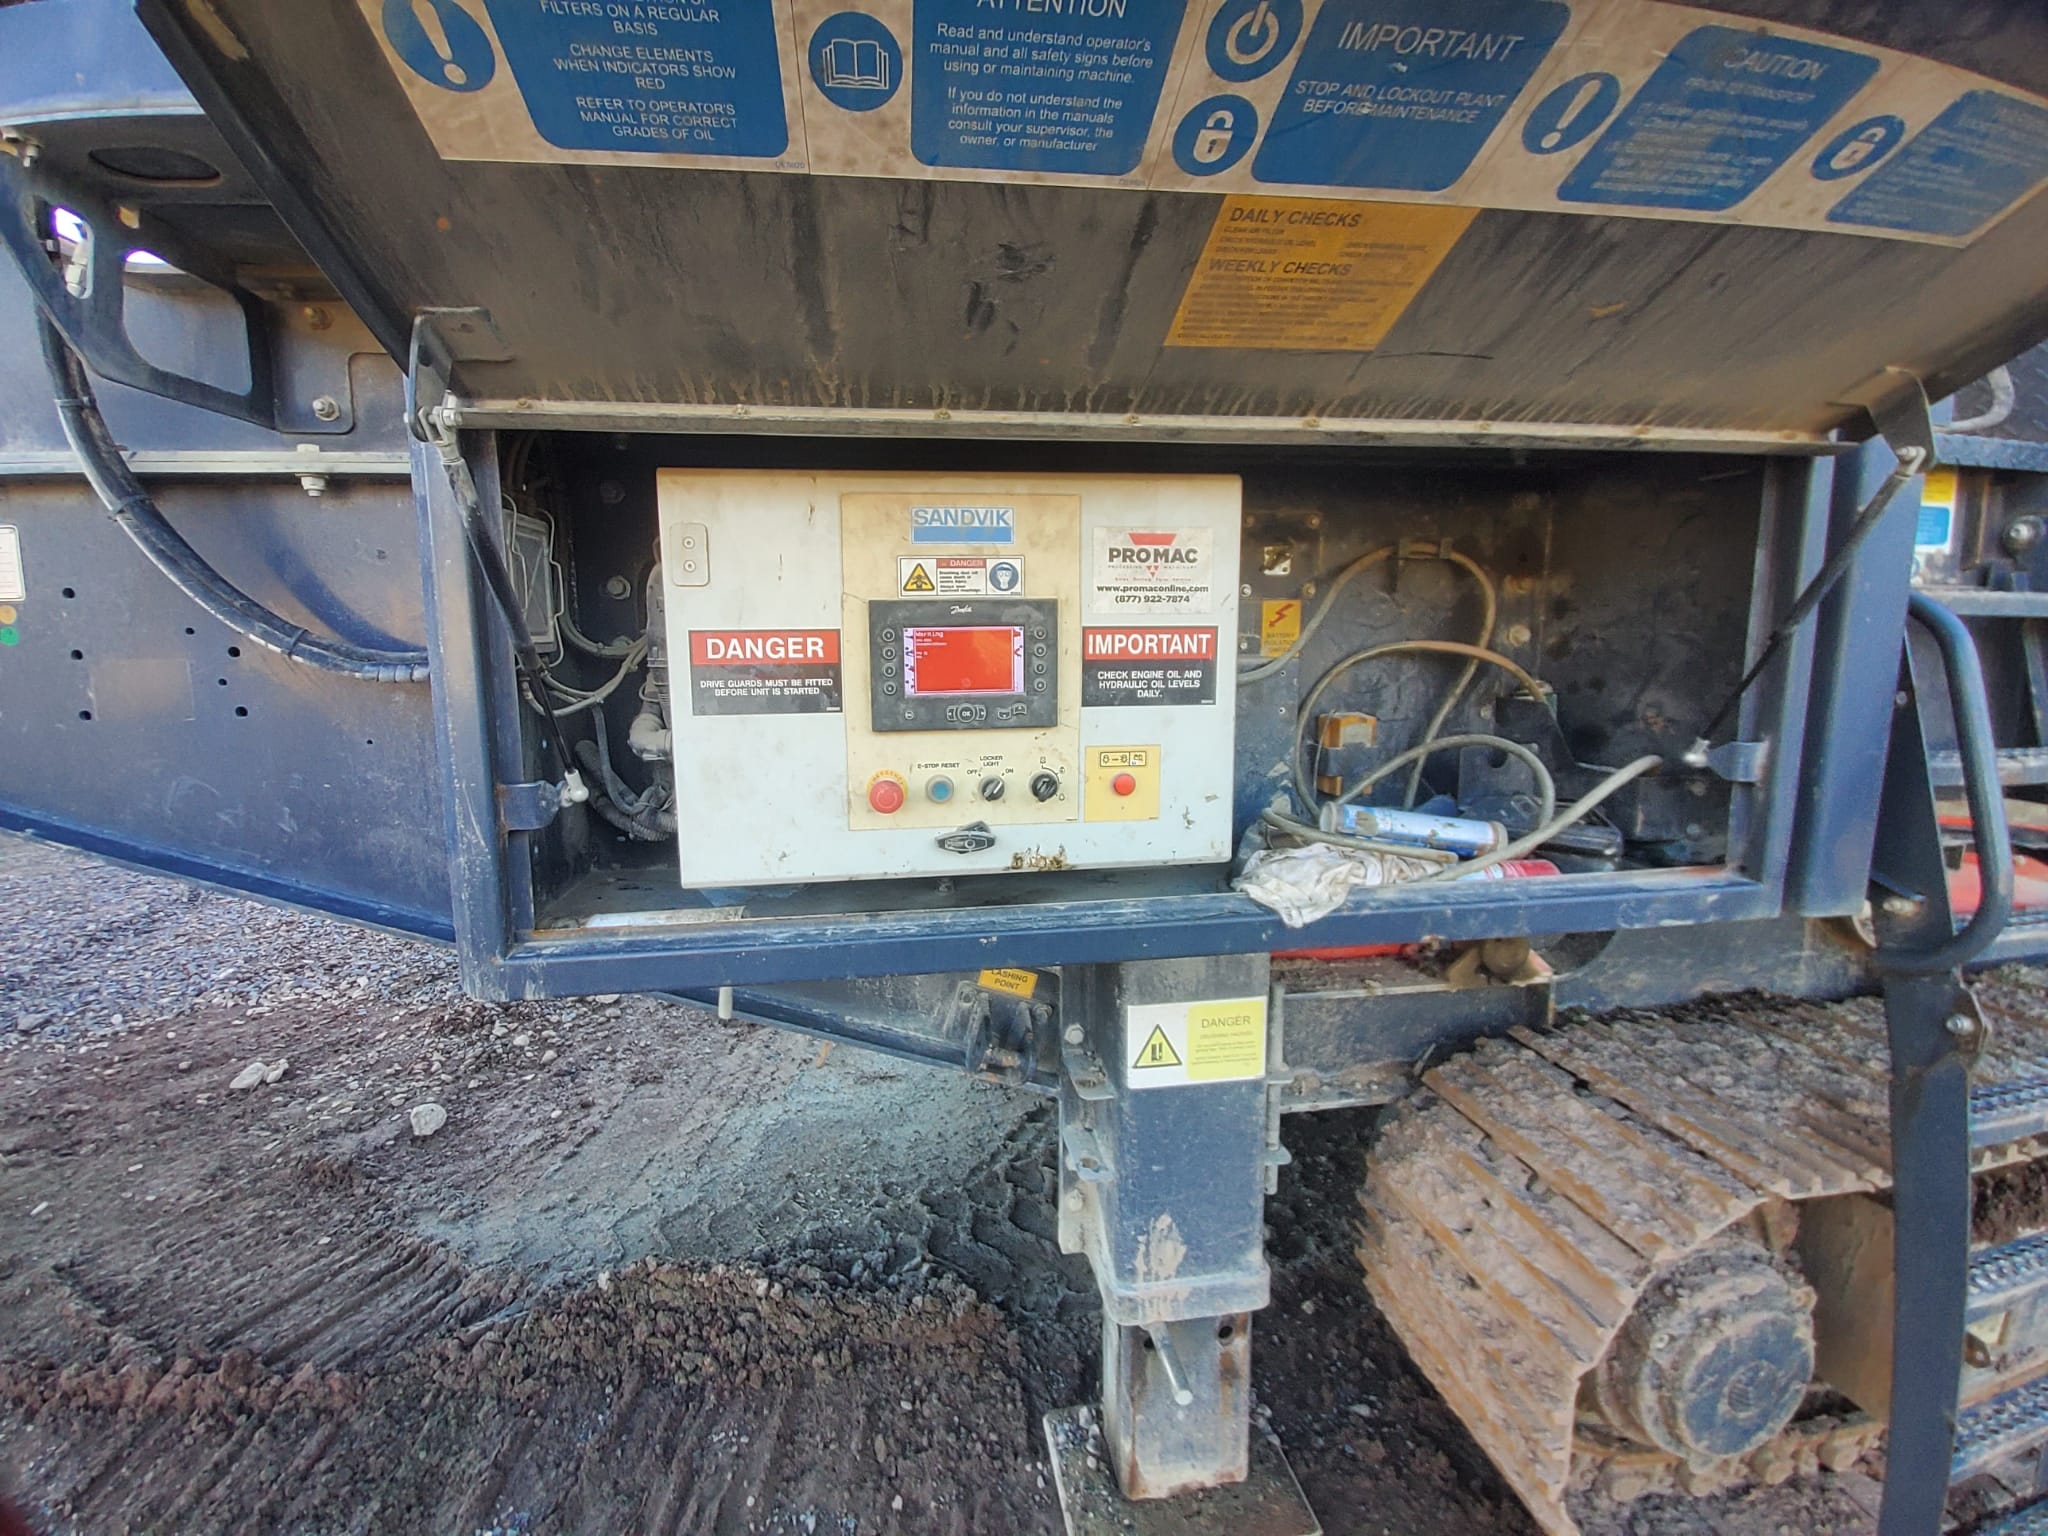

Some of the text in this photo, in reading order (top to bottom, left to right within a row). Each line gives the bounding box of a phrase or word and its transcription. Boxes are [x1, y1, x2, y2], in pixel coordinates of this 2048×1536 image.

[541, 0, 720, 22] FILTERS ON A REGULAR
[613, 21, 658, 36] BASIS
[937, 22, 1151, 52] Read and understand operator's
[1338, 21, 1525, 62] IMPORTANT
[570, 43, 714, 63] CHANGE ELEMENTS
[930, 42, 1153, 69] manual and all safety signs before
[553, 59, 736, 79] WHEN INDICATORS SHOW
[944, 59, 979, 76] using
[983, 64, 997, 74] or
[1000, 64, 1074, 82] maintaining
[1723, 48, 1830, 80] CAUTION
[636, 76, 665, 90] RED
[948, 87, 1123, 110] If you do not understand the
[1295, 80, 1507, 108] STOP AND LOCKOUT PLANT
[576, 97, 736, 116] REFER TO OPERATOR'S
[952, 102, 1114, 124] information in the manuals
[1303, 98, 1480, 124] BEFORE MAINTENANCE
[580, 111, 737, 129] MANUAL FOR CORRECT
[948, 119, 992, 132] consult
[995, 122, 1023, 136] your
[1095, 126, 1113, 139] the
[612, 125, 716, 142] GRADES OF OIL
[1004, 136, 1017, 148] or
[1230, 208, 1362, 228] DAILY CHECKS
[1209, 258, 1352, 276] WEEKLY CHECKS
[914, 508, 1010, 526] SANDVIK
[950, 559, 984, 567] DANGER
[1108, 547, 1198, 564] PROMAC
[1097, 584, 1209, 594] www.promaconline.com
[1115, 595, 1190, 604] (877) 922-7874
[706, 637, 824, 660] DANGER
[1088, 633, 1211, 655] IMPORTANT
[700, 680, 724, 688] DRIVE
[765, 679, 788, 687] MUST
[805, 678, 833, 686] FITTED
[1098, 670, 1203, 680] CHECK ENGINE OIL AND
[715, 688, 748, 697] BEFORE
[751, 688, 769, 696] UNIT
[784, 687, 820, 695] STARTED
[1099, 680, 1201, 689] HYDRAULIC OIL LEVELS
[1137, 690, 1163, 698] DAILY.
[994, 978, 1021, 991] POINT
[1201, 1015, 1251, 1029] DANGER
